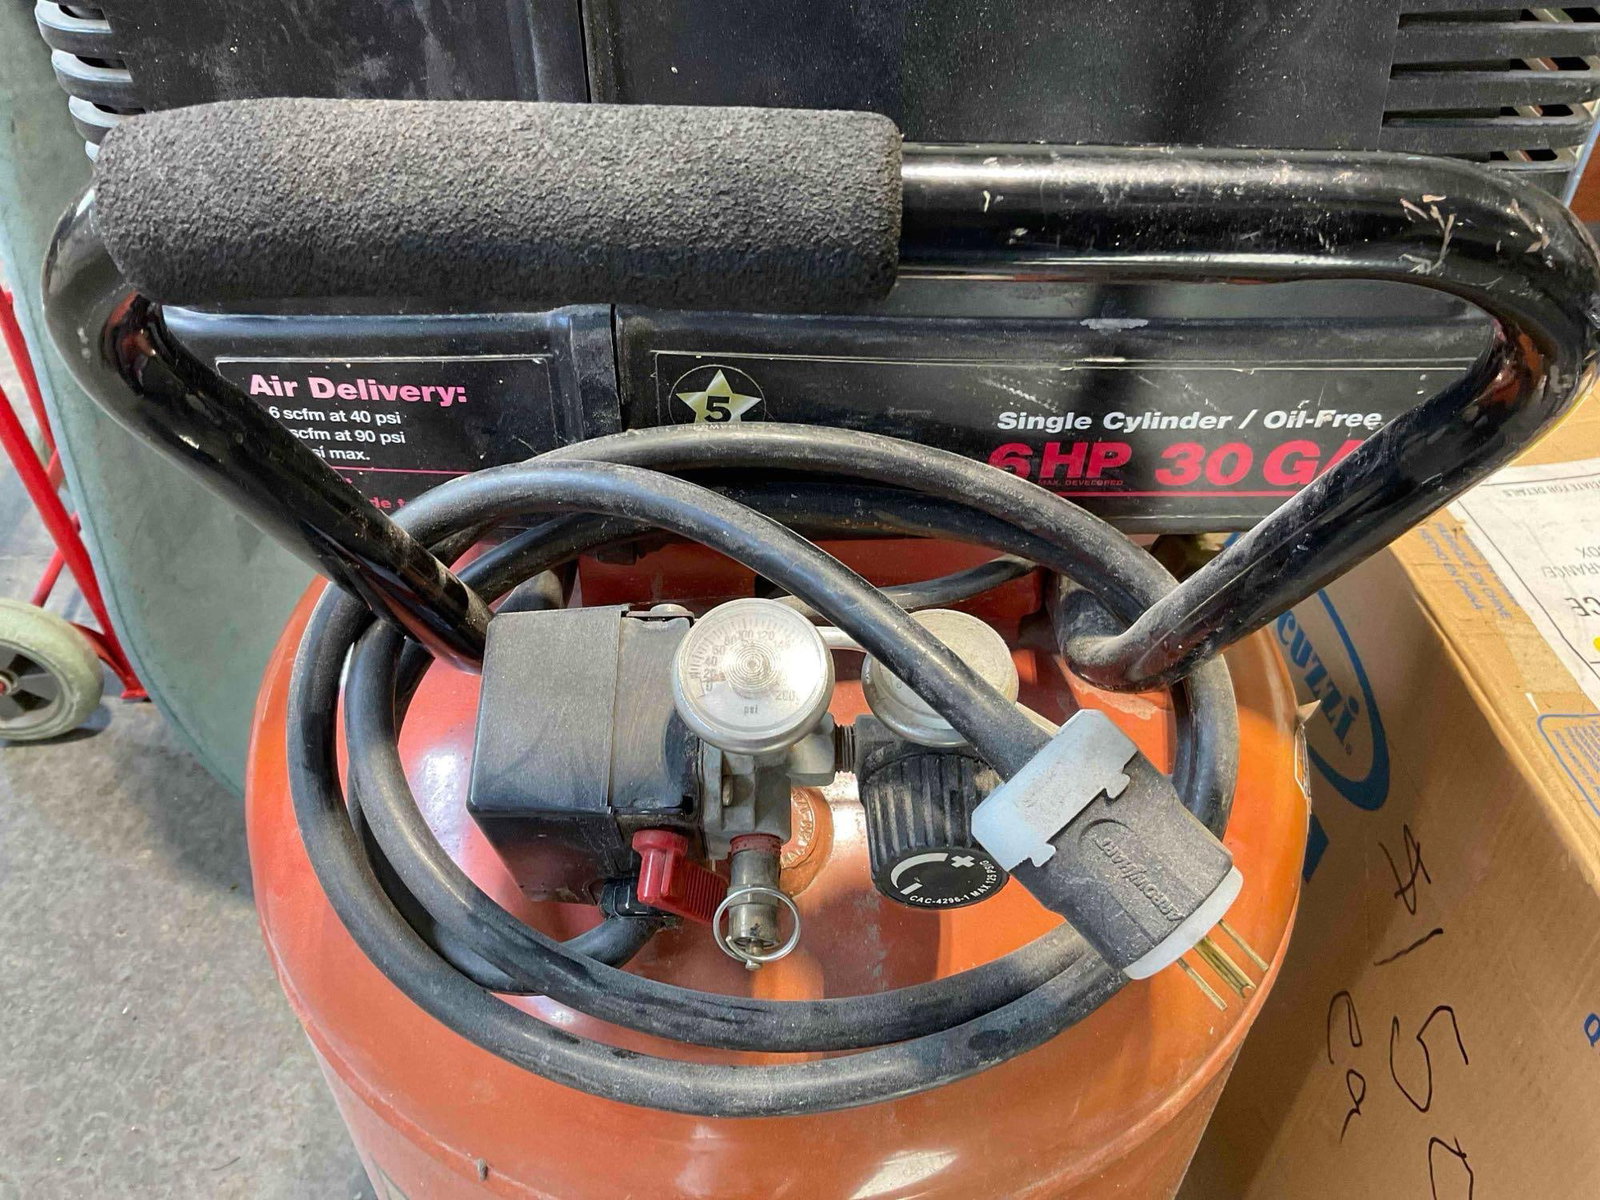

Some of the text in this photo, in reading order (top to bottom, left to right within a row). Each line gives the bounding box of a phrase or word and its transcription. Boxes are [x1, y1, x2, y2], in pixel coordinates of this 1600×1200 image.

[250, 374, 467, 406] Air Delivery:
[283, 407, 325, 421] scfm
[329, 409, 348, 423] at
[350, 410, 371, 423] 40
[375, 411, 402, 426] psi
[704, 395, 732, 422] 5
[997, 408, 1384, 435] Single Cylinder / Oil-Free
[334, 429, 353, 442] at
[354, 429, 376, 443] 90
[379, 431, 406, 446] psi
[329, 448, 371, 460] max.
[1155, 442, 1252, 486] 30
[1065, 479, 1124, 487] DEVELOPED
[743, 703, 758, 717] psi
[909, 893, 971, 905] CAC-4296-1
[970, 884, 991, 898] MAX
